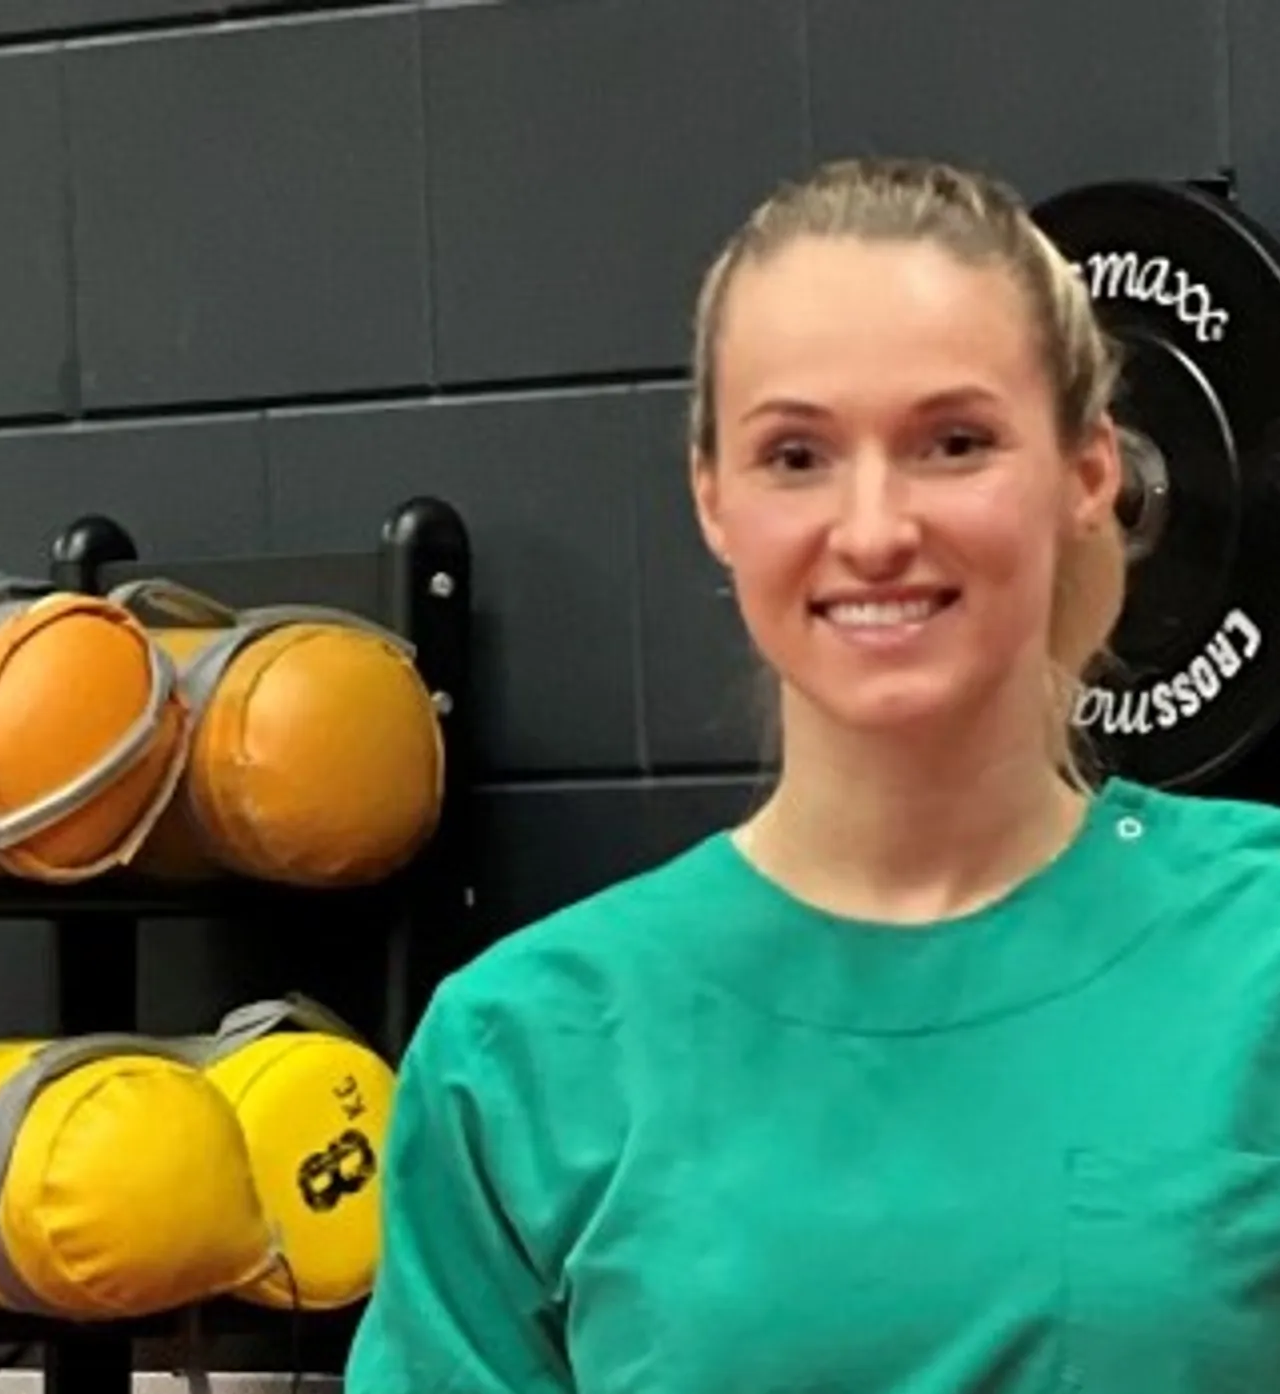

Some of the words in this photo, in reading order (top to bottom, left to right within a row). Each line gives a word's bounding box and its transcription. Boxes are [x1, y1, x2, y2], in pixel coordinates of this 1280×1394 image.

[1070, 251, 1230, 342] maxx
[1072, 608, 1262, 734] CROSSma
[297, 1128, 377, 1213] 8
